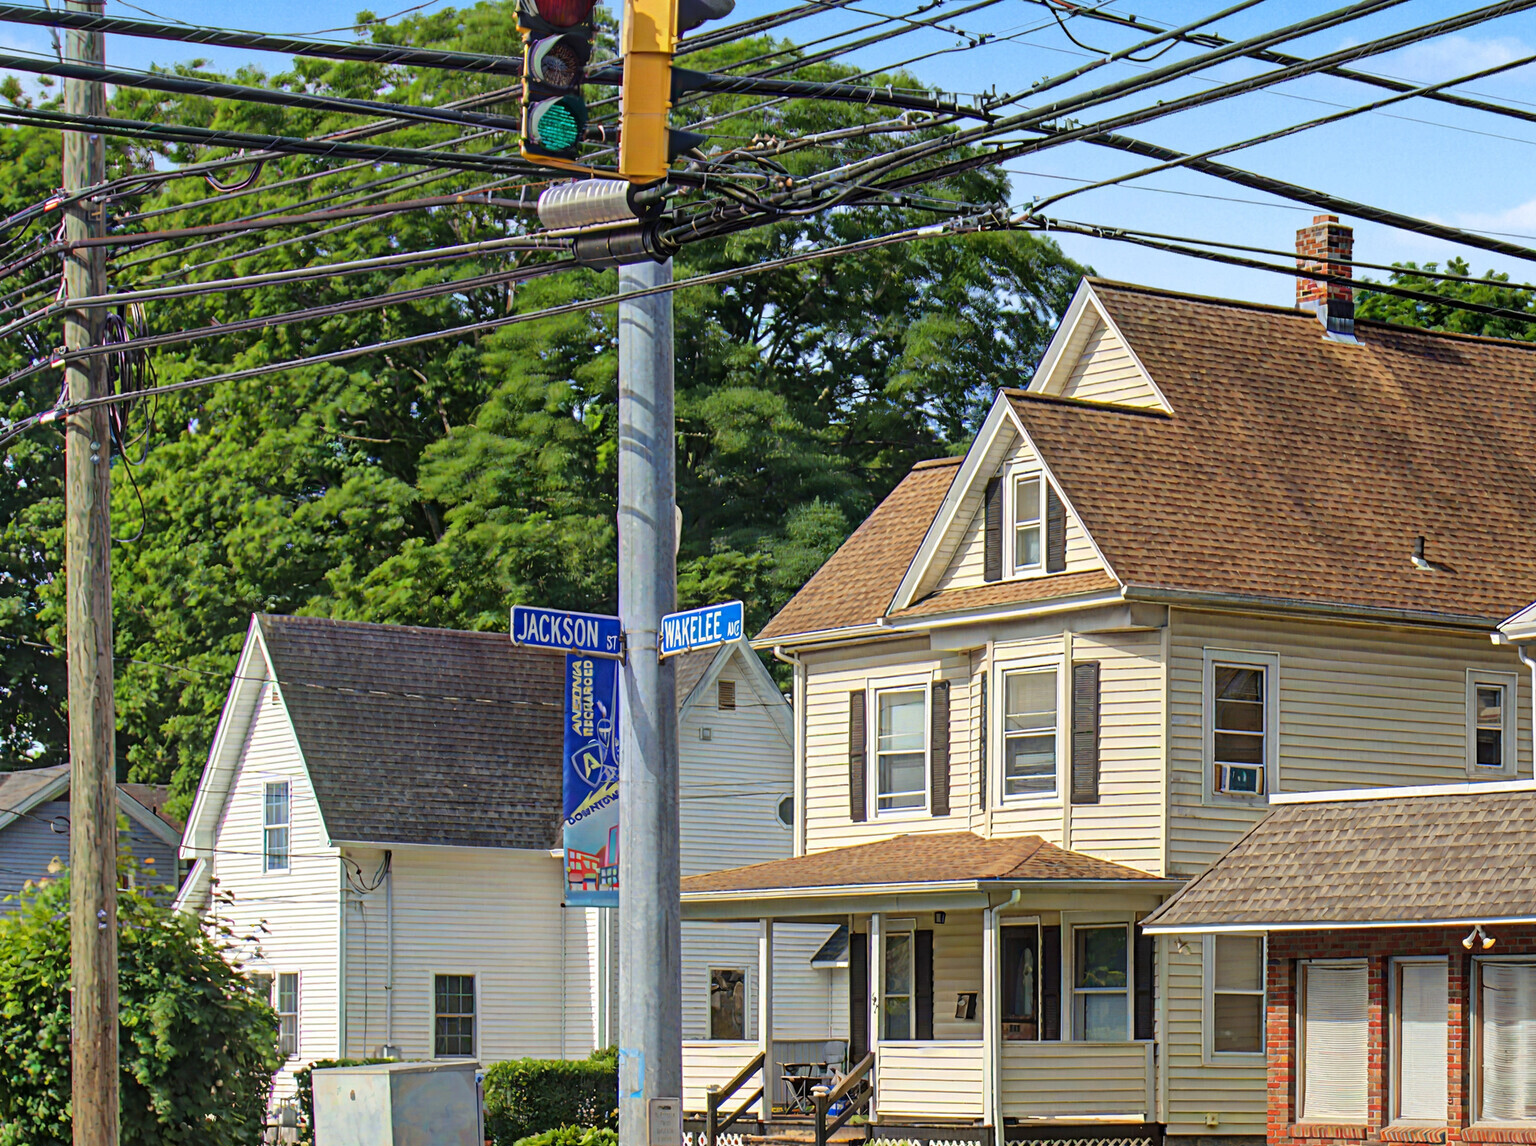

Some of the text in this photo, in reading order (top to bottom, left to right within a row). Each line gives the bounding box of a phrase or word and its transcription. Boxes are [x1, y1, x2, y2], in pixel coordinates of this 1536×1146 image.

[516, 612, 618, 650] JACKSON ST
[664, 611, 722, 649] WAKELEE
